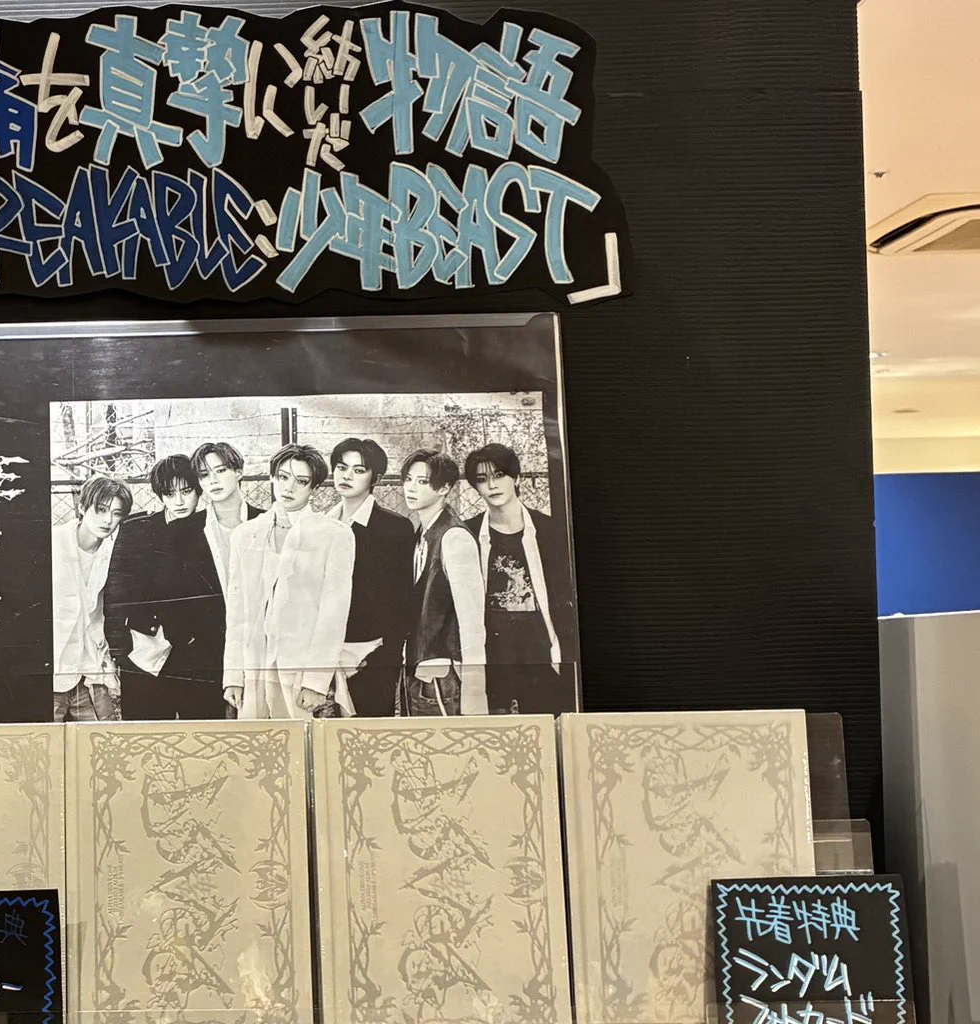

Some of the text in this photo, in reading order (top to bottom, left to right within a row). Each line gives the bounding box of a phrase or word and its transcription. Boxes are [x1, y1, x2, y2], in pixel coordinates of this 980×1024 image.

[734, 895, 861, 945] 先着特典
[732, 947, 852, 998] ランダム
